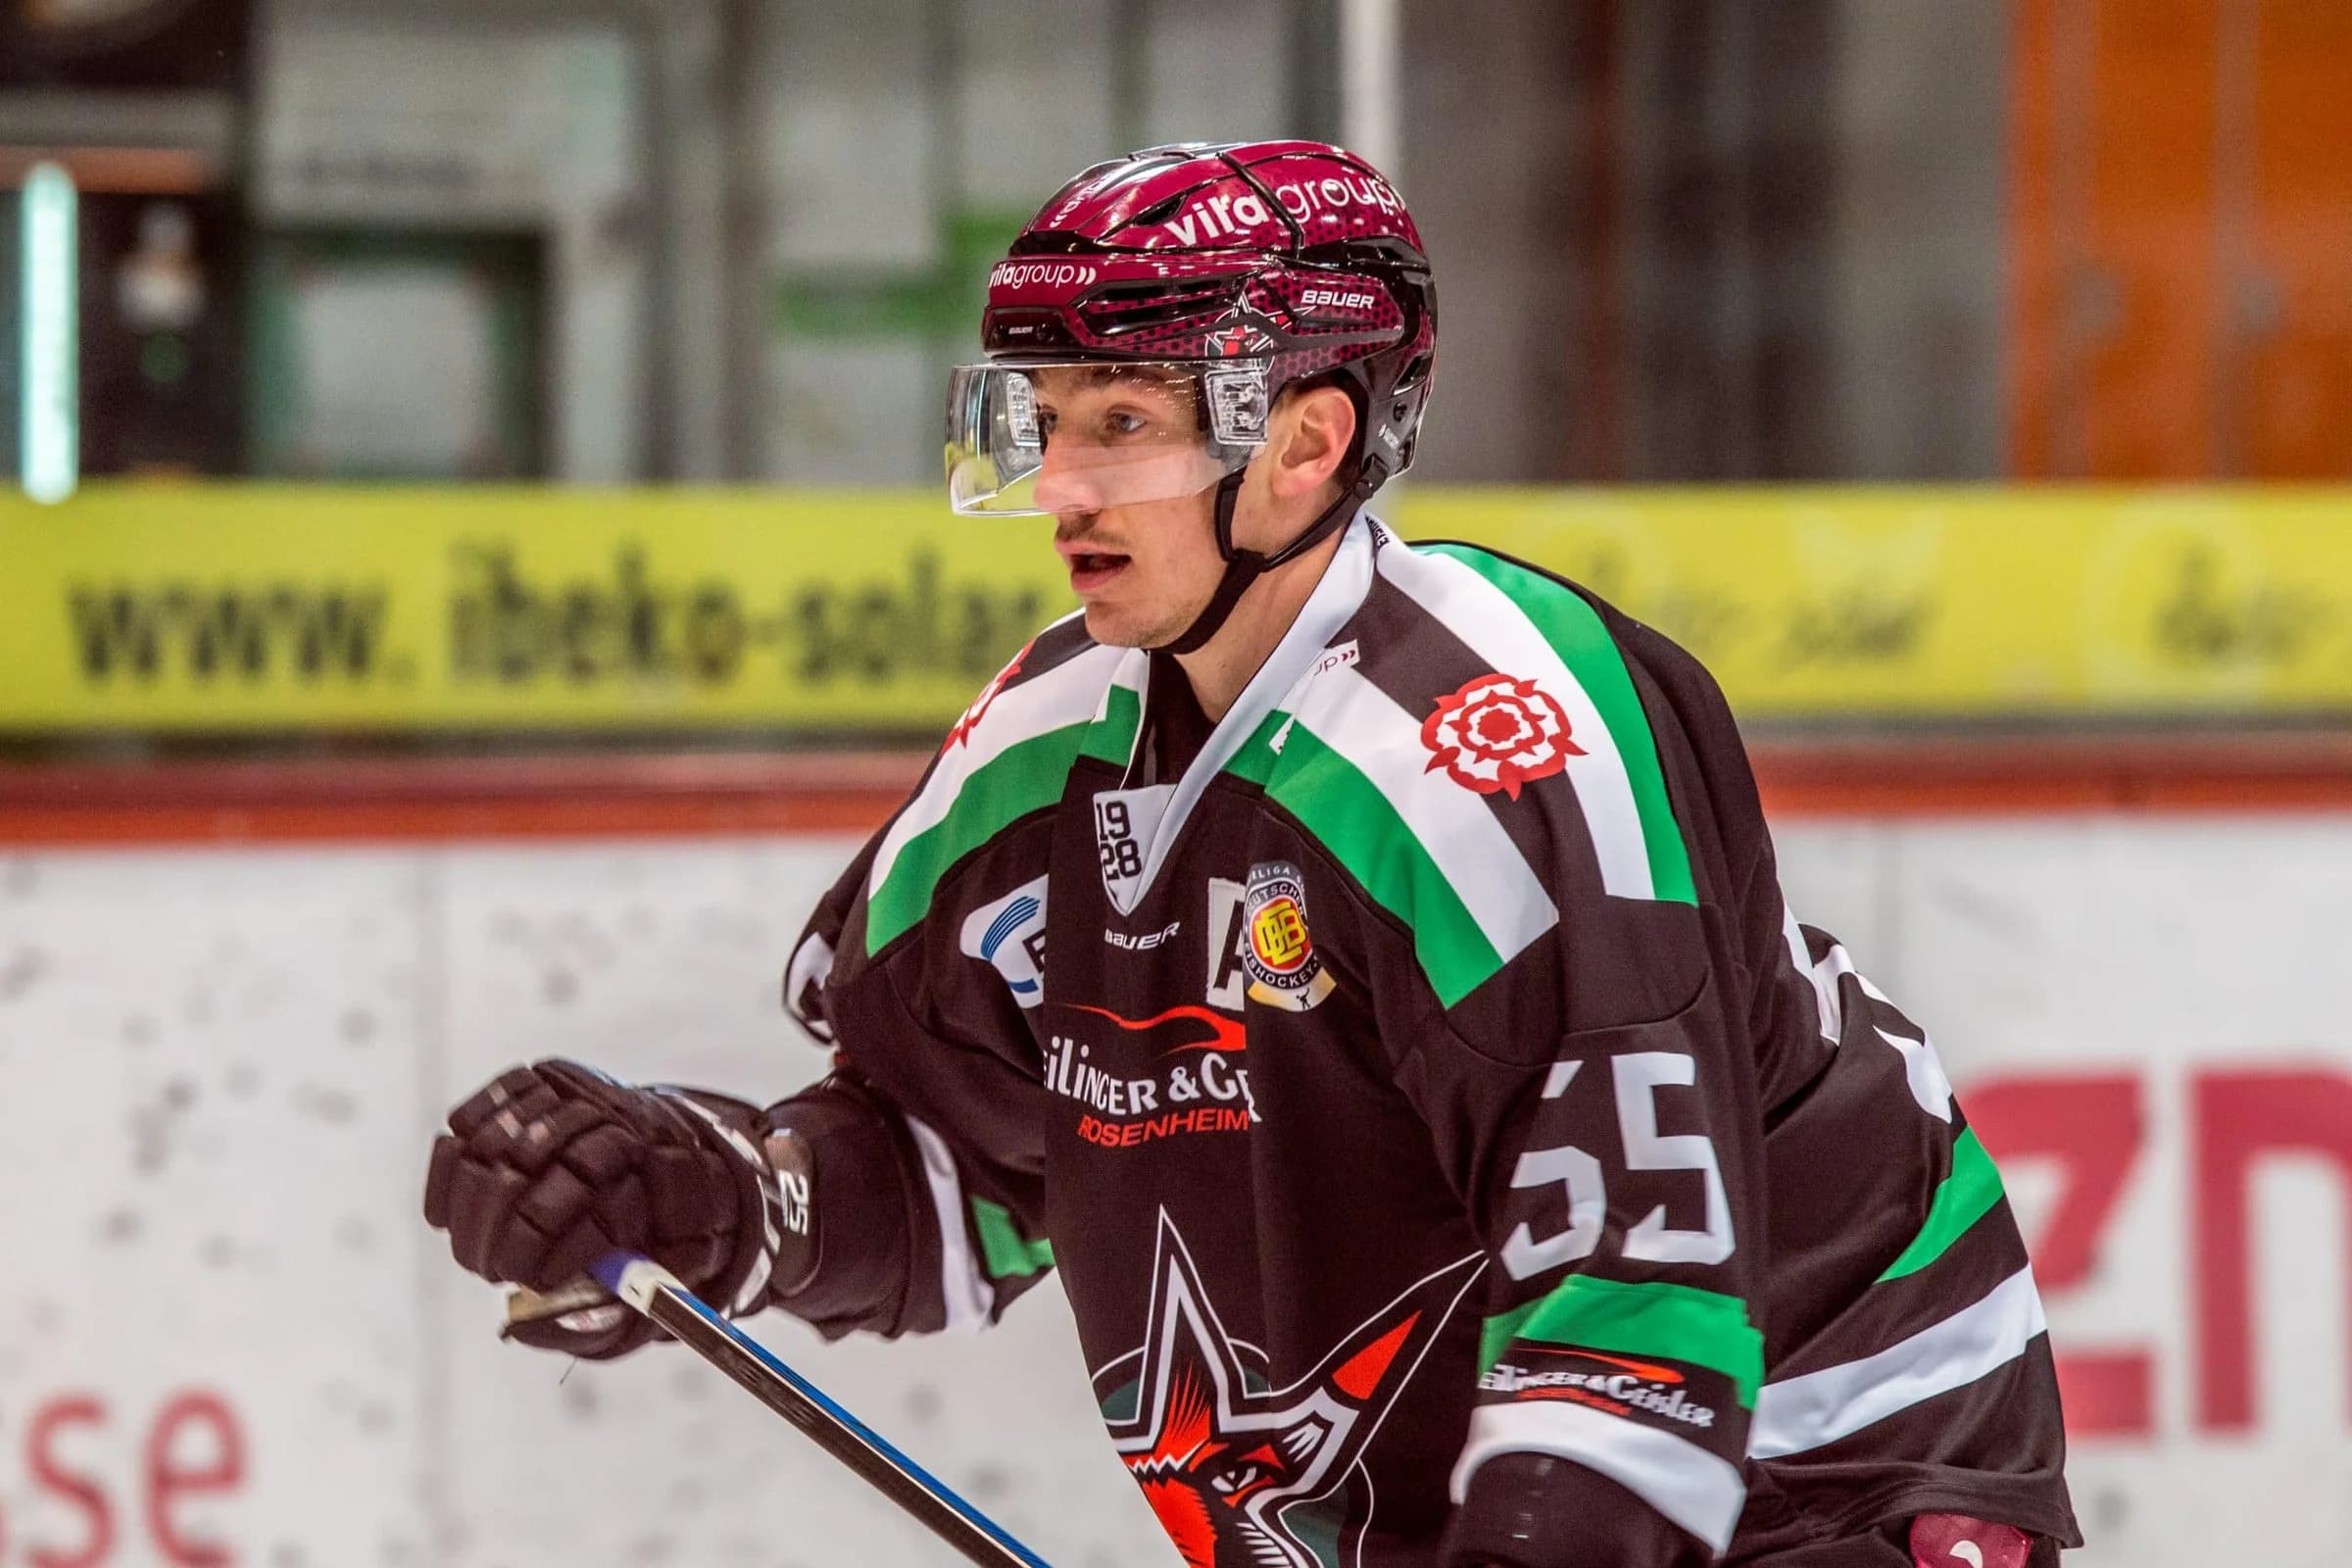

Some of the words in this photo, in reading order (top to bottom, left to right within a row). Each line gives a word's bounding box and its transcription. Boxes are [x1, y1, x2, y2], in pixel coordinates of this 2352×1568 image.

[1300, 288, 1375, 310] BAUER
[1096, 799, 1131, 842] 19
[1100, 837, 1143, 881] 28
[1103, 920, 1181, 951] BAUER
[1078, 1108, 1250, 1149] ROSENHEIM
